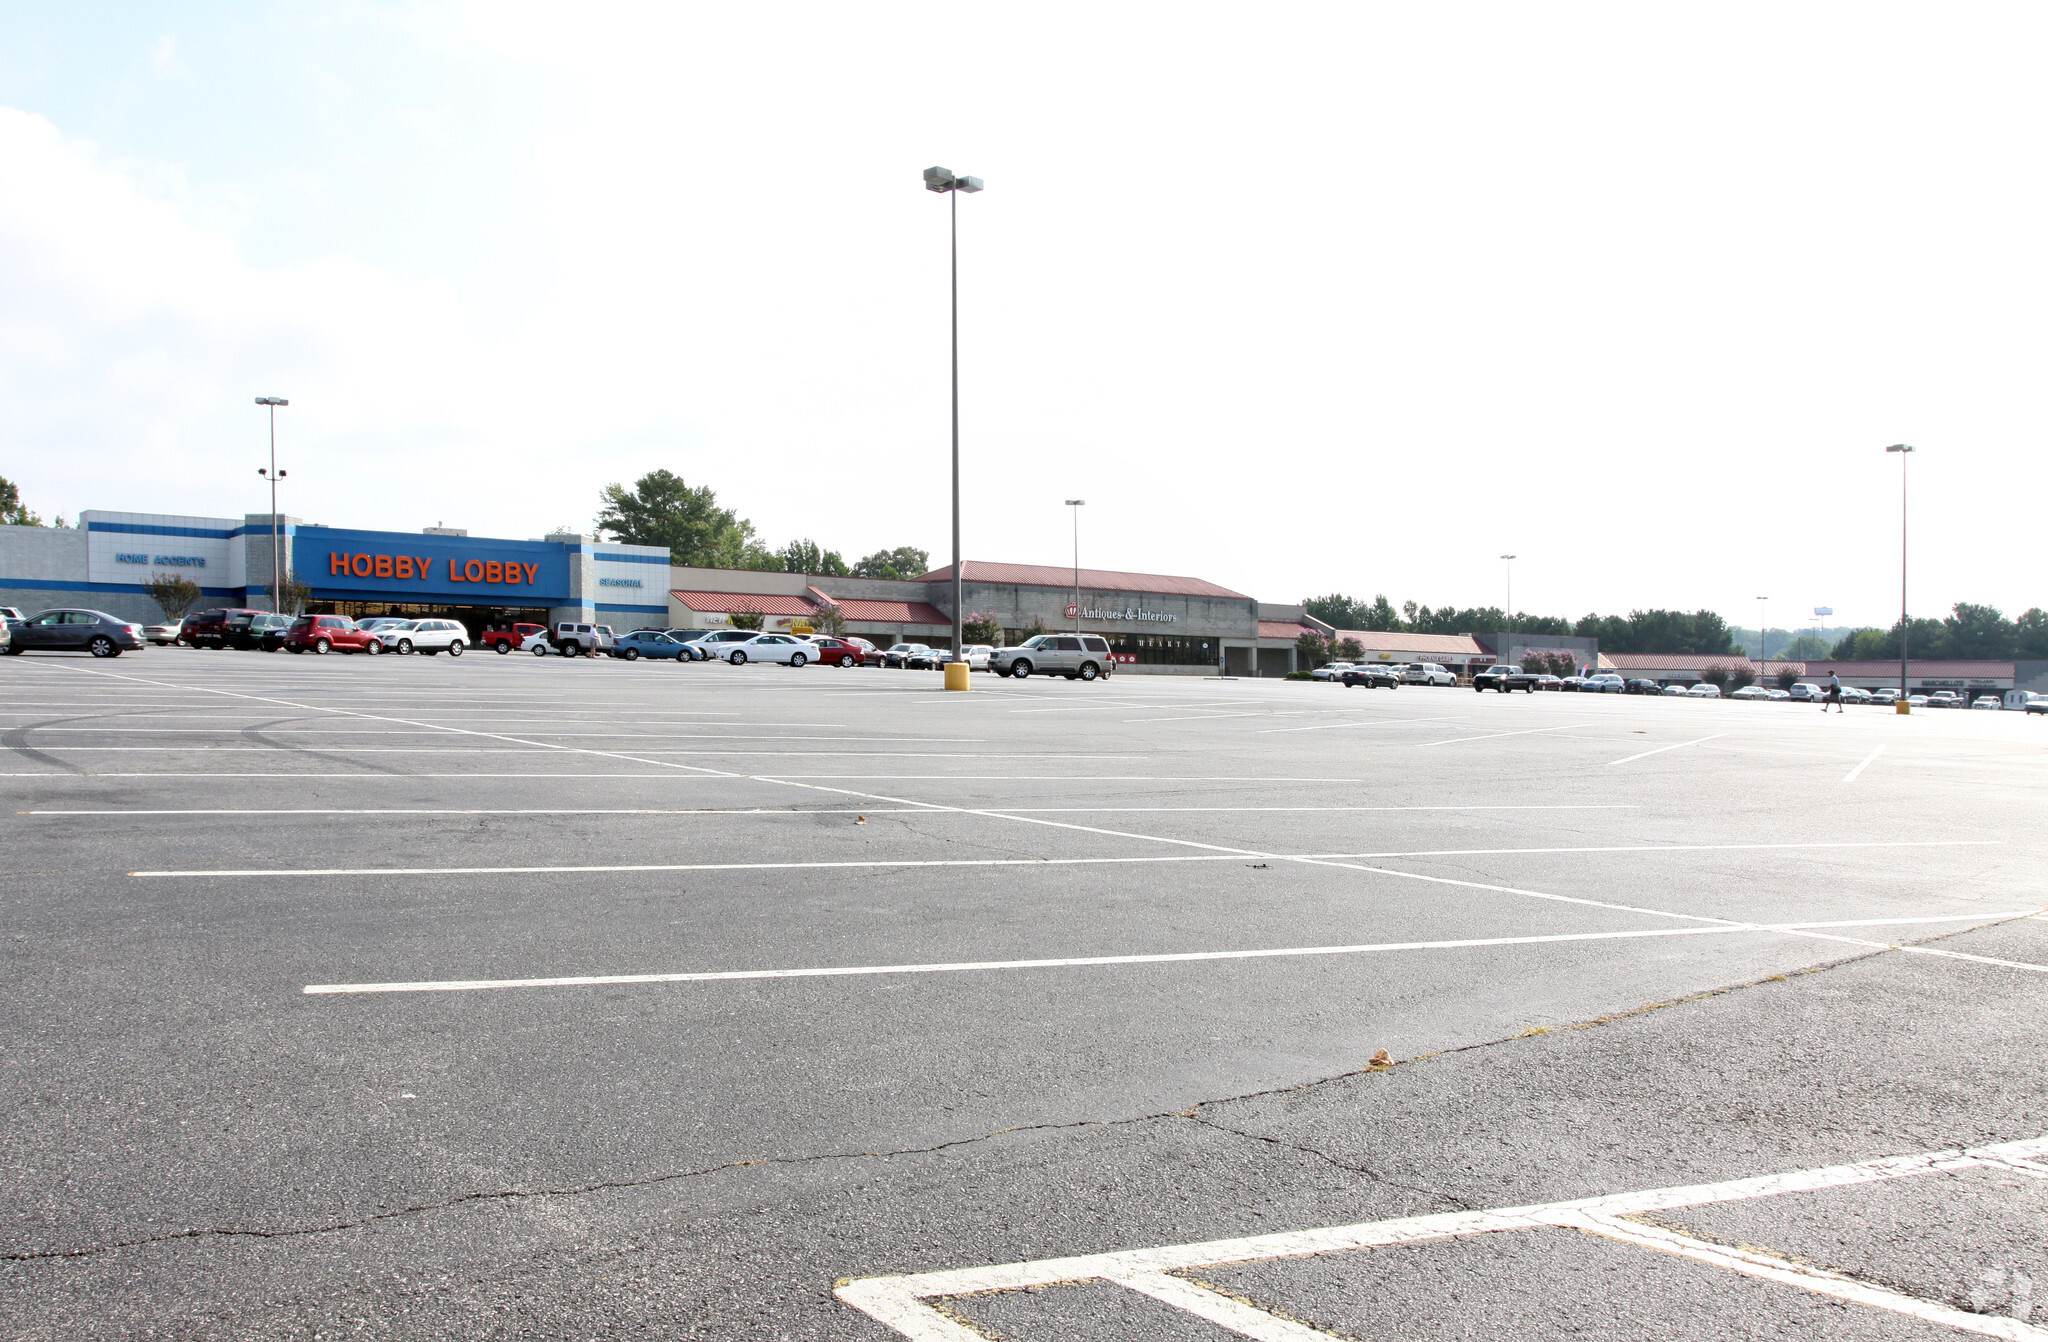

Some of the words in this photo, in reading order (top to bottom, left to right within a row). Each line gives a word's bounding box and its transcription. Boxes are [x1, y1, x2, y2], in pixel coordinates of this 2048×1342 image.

[116, 553, 148, 564] HOME
[154, 555, 206, 567] ACCENTS
[330, 552, 432, 580] HOBBY
[450, 558, 539, 584] LOBBY
[600, 578, 643, 588] SEASONAL
[1081, 606, 1121, 620] Antiques
[1138, 608, 1177, 622] Interiors
[1139, 640, 1190, 648] HEARTS
